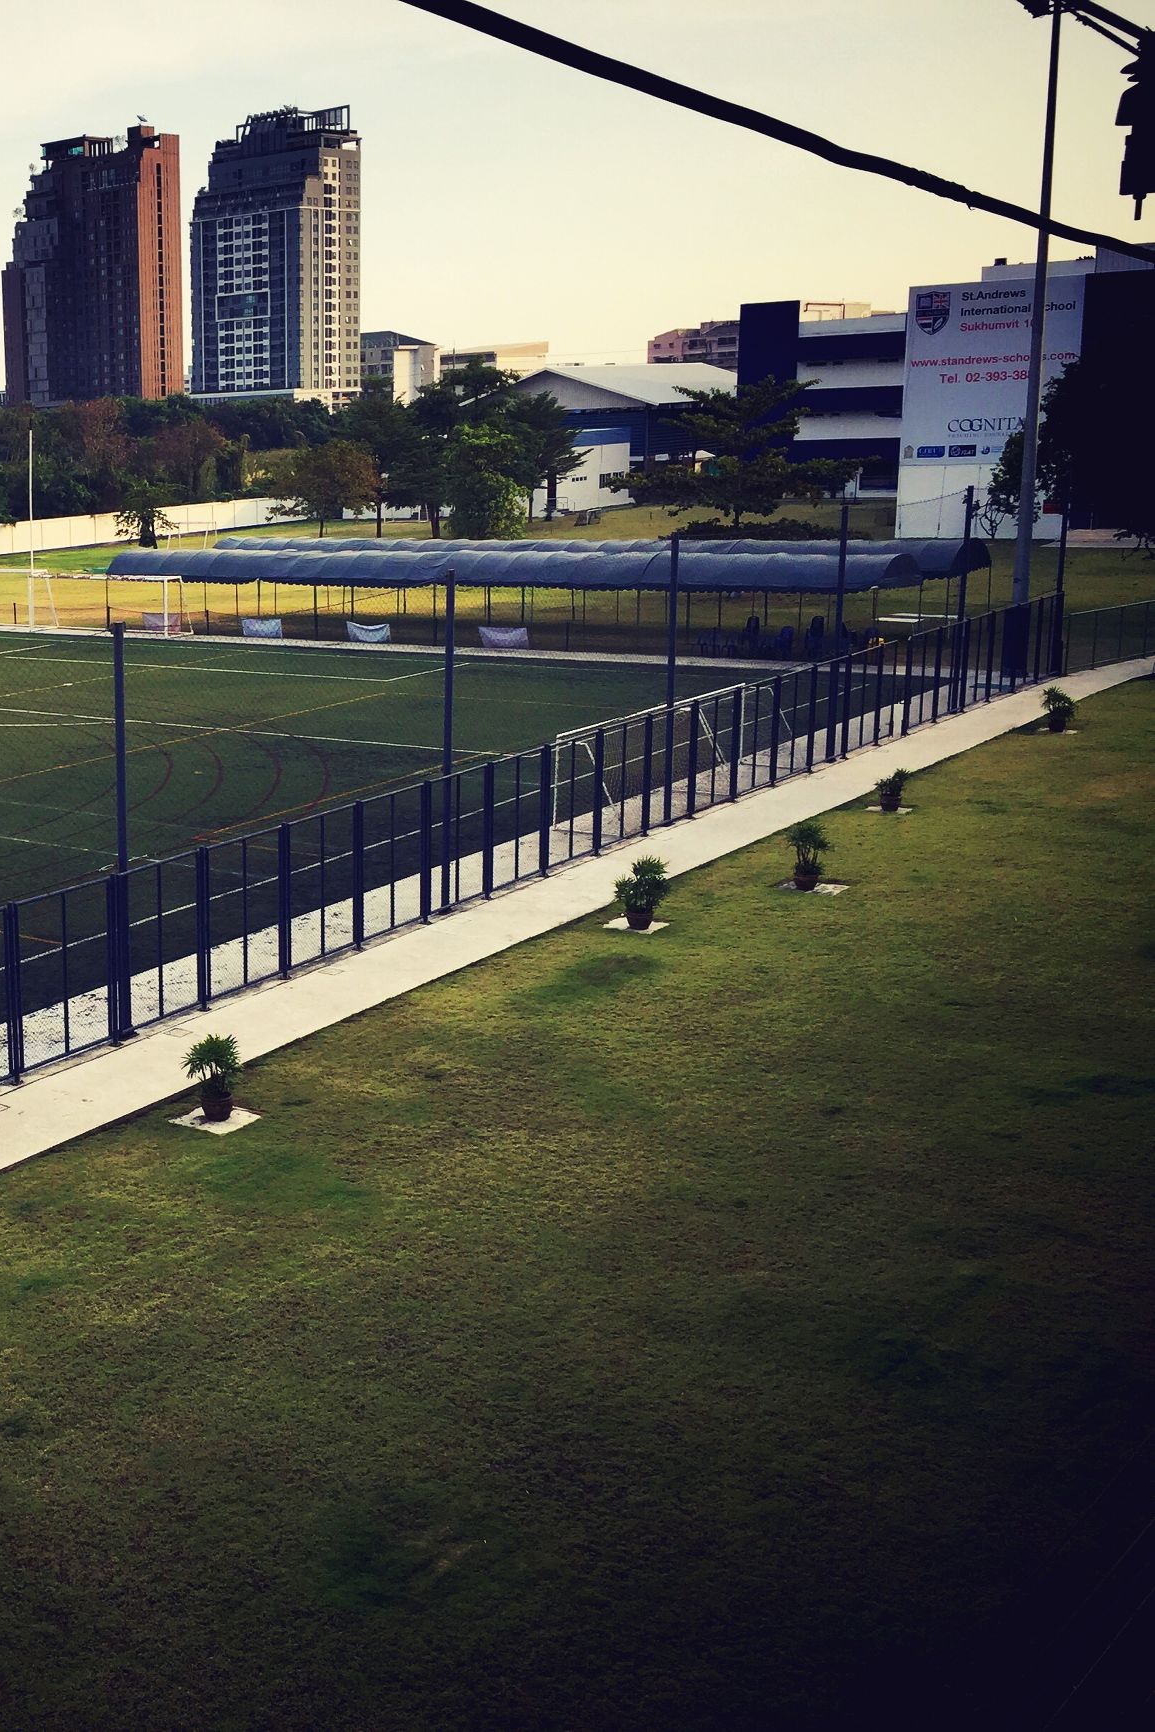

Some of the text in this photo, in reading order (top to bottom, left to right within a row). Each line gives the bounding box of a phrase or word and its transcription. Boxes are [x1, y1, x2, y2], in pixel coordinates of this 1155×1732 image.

[961, 289, 1026, 301] St.Andrews
[960, 301, 1076, 317] International chool
[960, 320, 1019, 332] Sukhumvit
[911, 351, 1076, 367] www.standrews-schos.com
[939, 373, 960, 384] Tel.
[947, 416, 1025, 433] COGNITA
